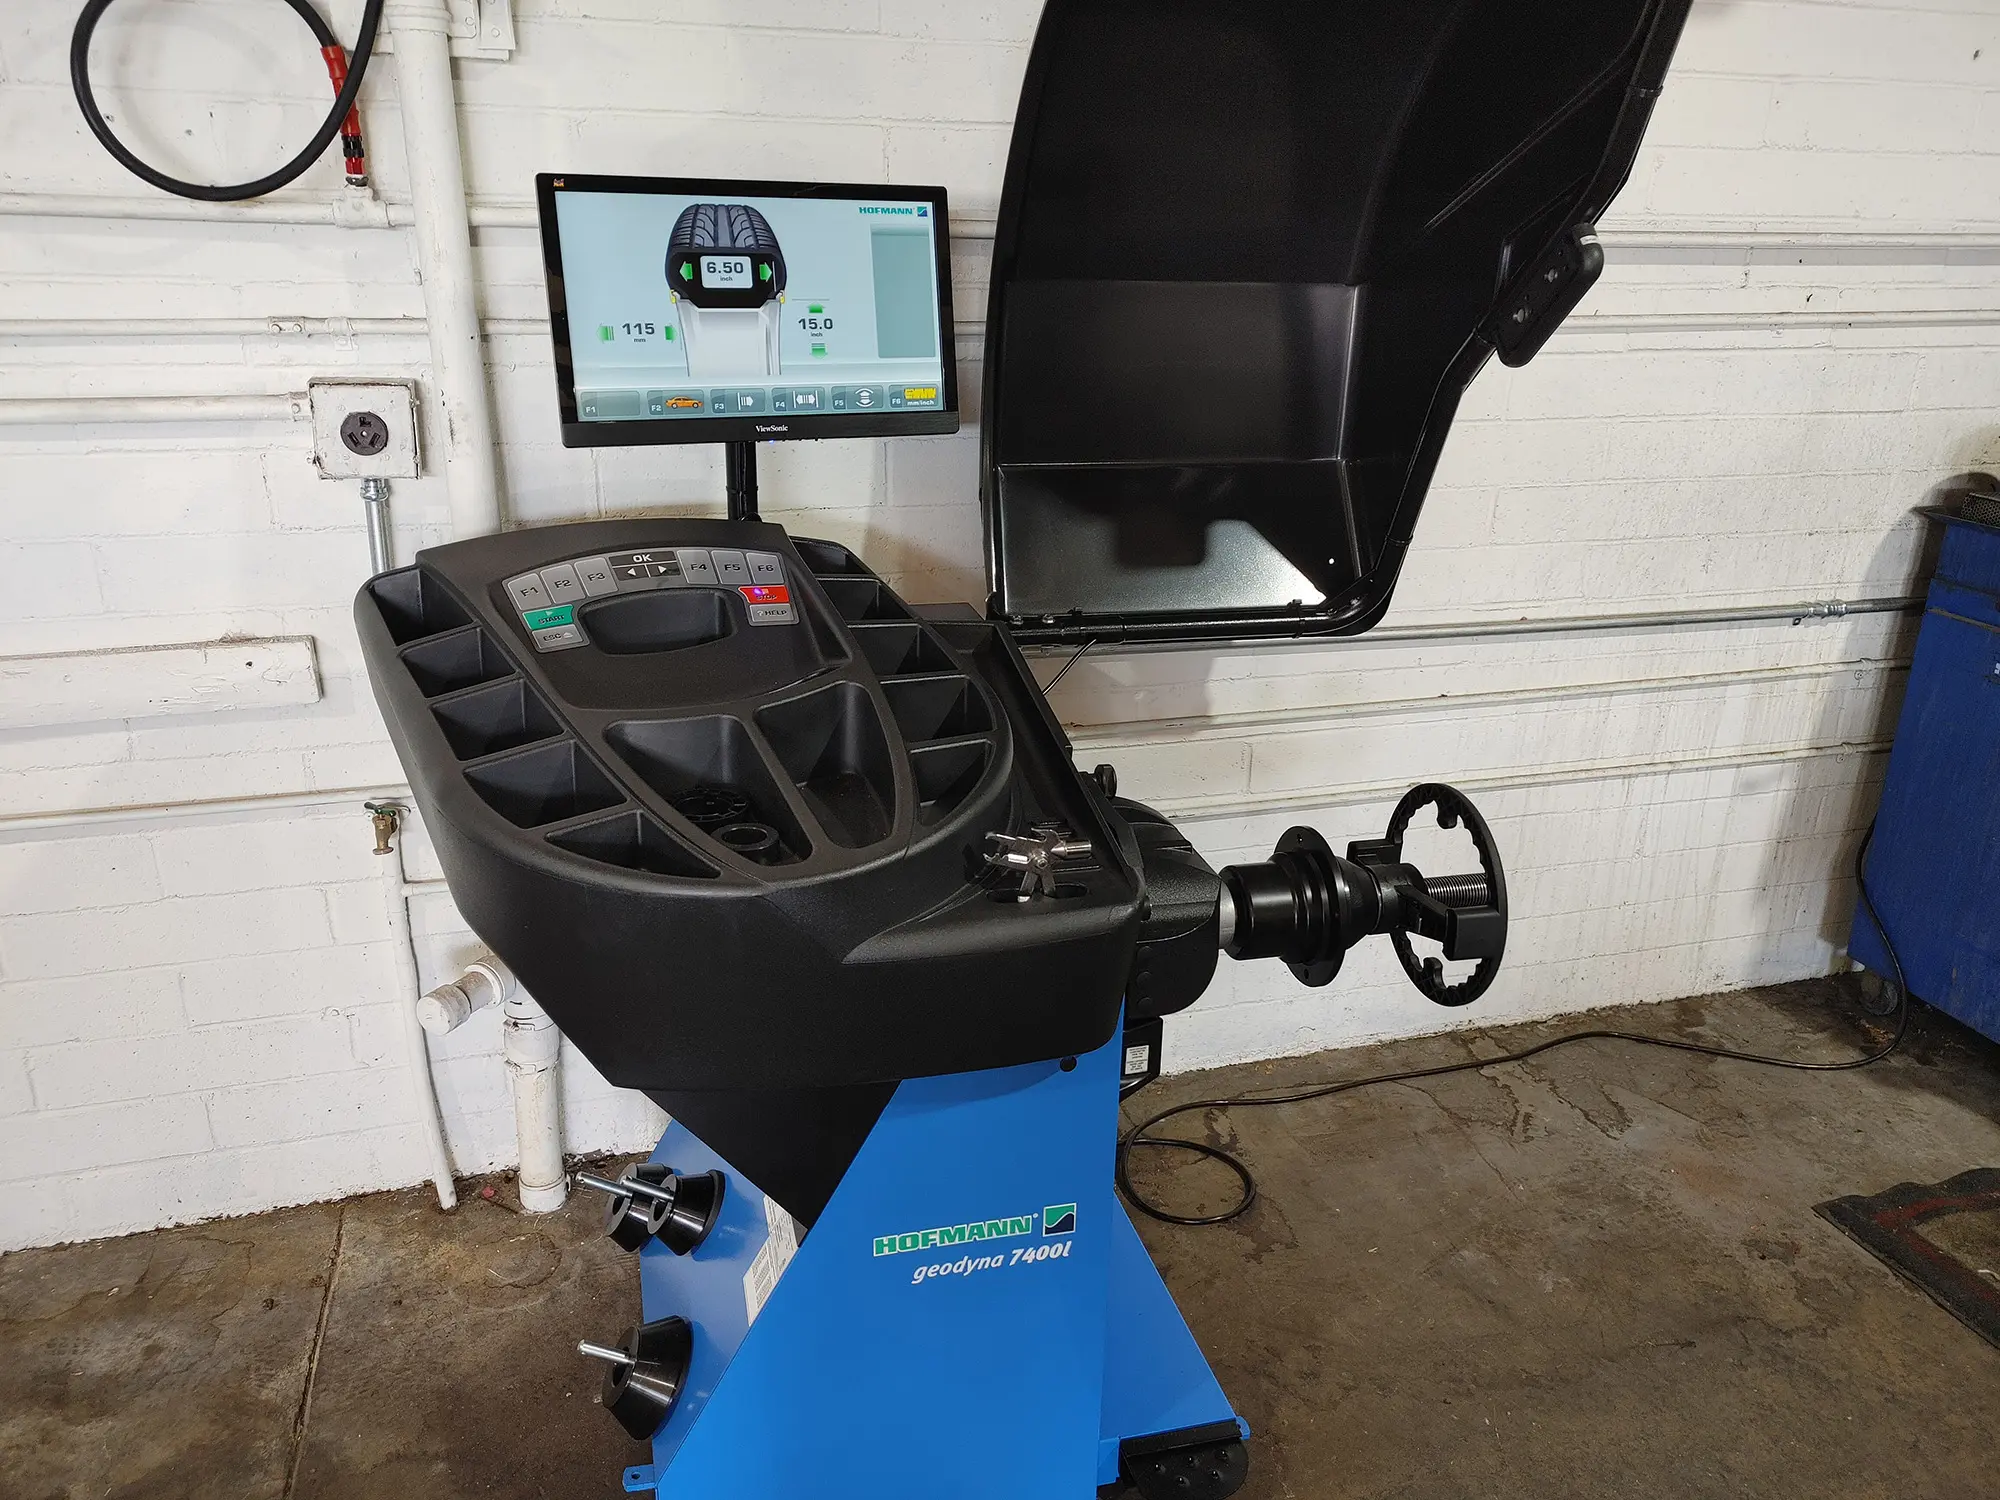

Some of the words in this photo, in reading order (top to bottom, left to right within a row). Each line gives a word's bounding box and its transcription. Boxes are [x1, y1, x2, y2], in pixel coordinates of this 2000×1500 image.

[858, 206, 913, 215] HOFMANN
[706, 261, 744, 274] 6.50
[621, 322, 655, 335] 115
[798, 318, 833, 330] 15.0
[651, 404, 662, 412] F2
[775, 401, 785, 409] F4
[834, 399, 844, 407] F5
[585, 406, 596, 414] F1
[755, 424, 789, 433] ViewSonic
[632, 553, 653, 563] OK
[690, 563, 708, 571] F4
[724, 563, 741, 571] F5
[757, 564, 774, 572] F6
[587, 571, 605, 582] F3
[554, 579, 572, 589] F2
[520, 586, 539, 597] F1
[538, 614, 565, 624] START
[543, 632, 562, 642] ESC
[873, 1215, 1033, 1257] HOFMANN
[911, 1253, 1004, 1285] geodyna
